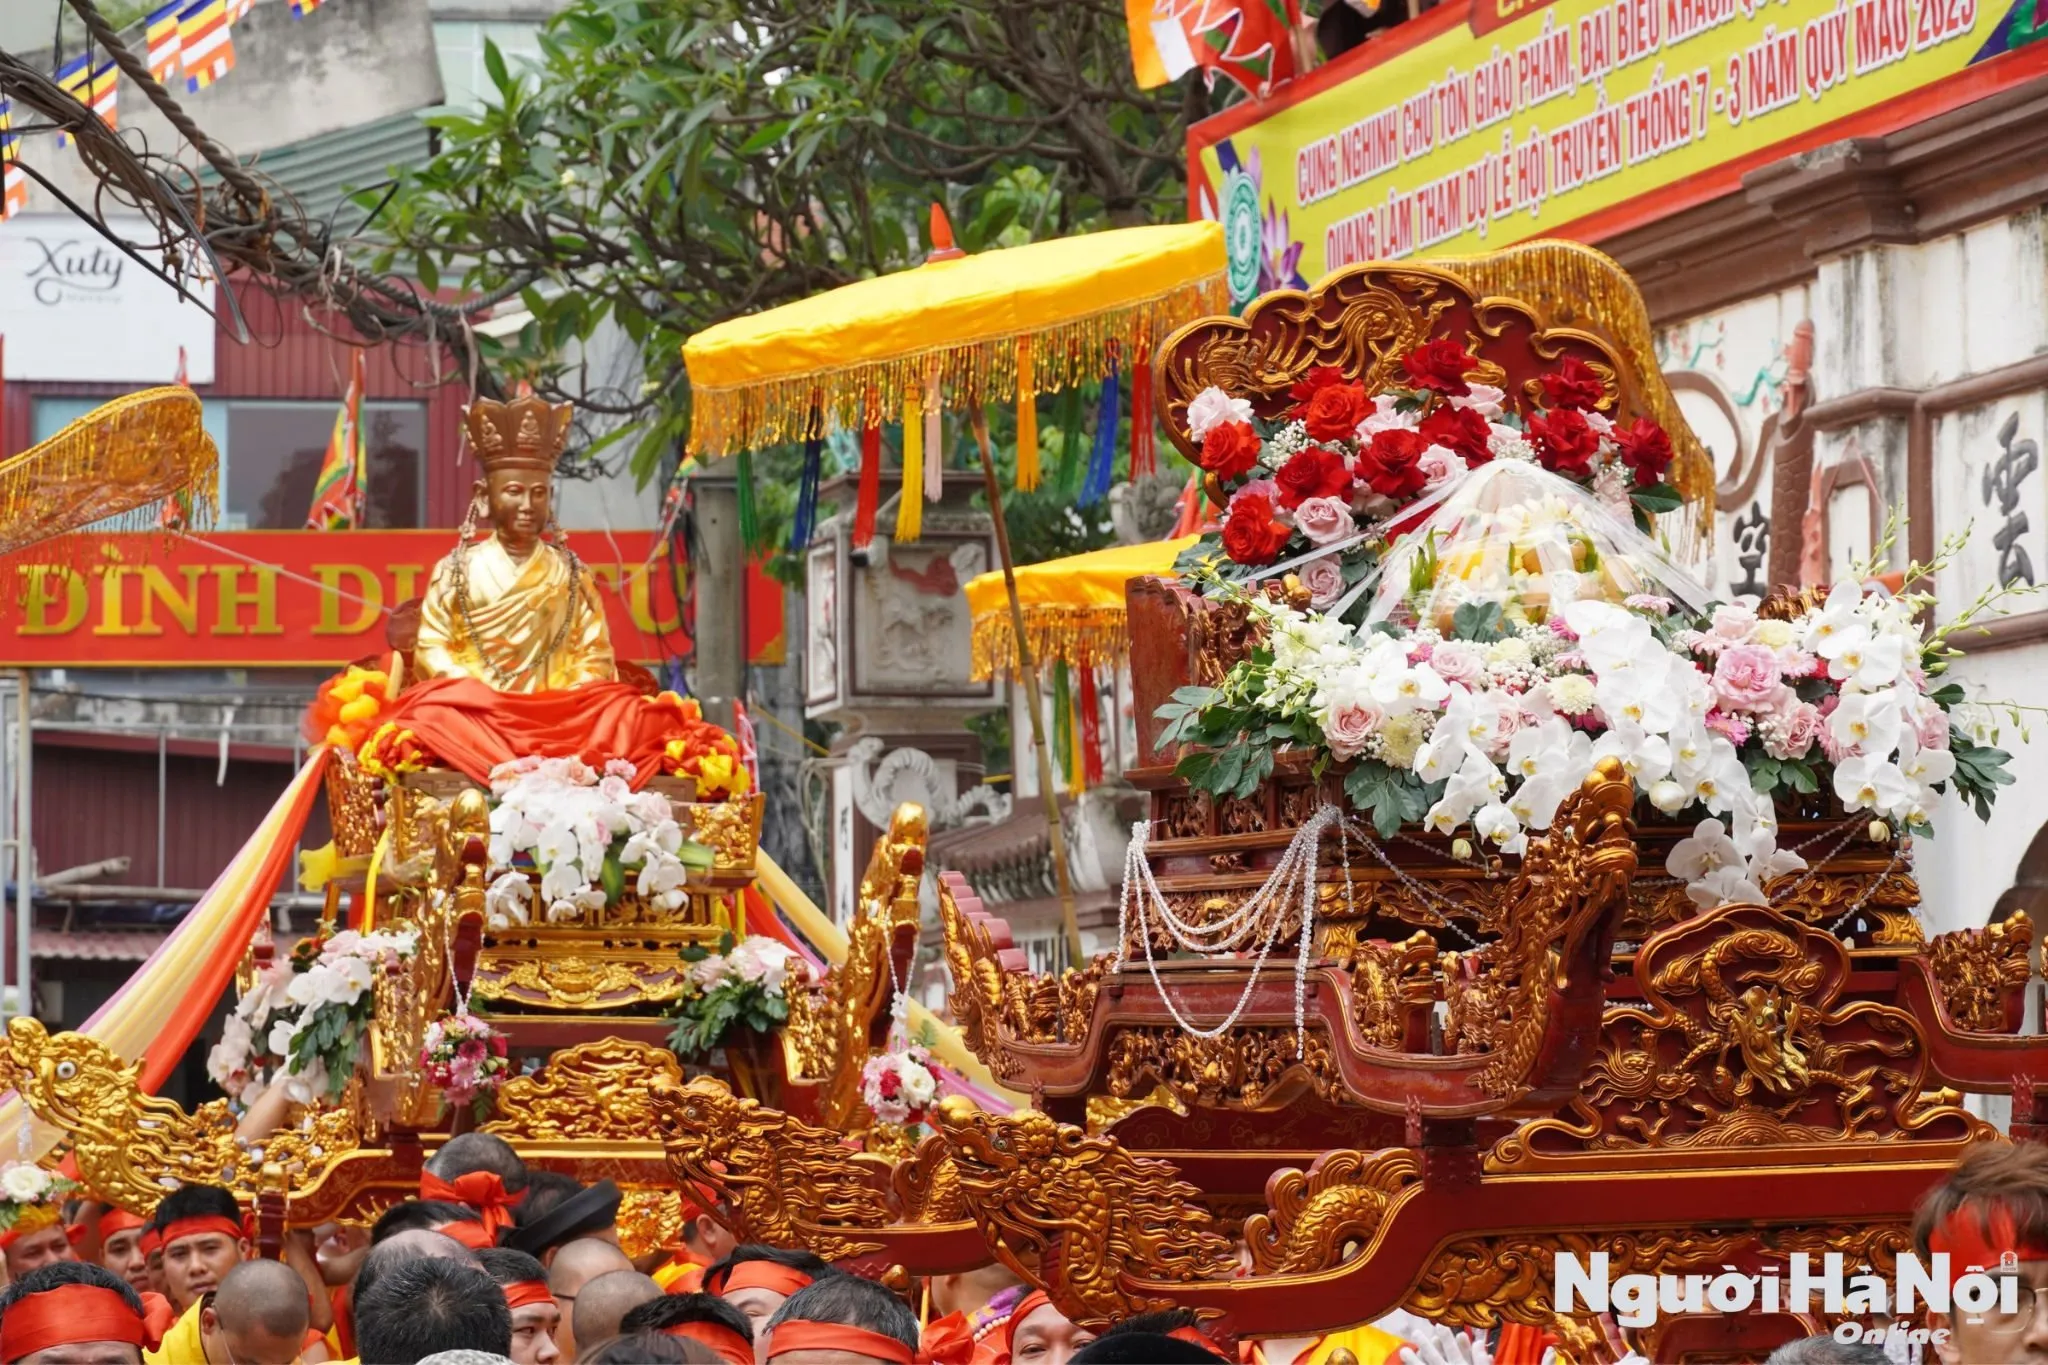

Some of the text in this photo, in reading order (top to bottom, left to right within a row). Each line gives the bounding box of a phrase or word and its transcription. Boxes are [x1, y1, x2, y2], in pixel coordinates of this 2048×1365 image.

[1298, 135, 1338, 205] CUNG
[1341, 107, 1398, 188] NGHINH
[1403, 83, 1437, 161] CHƯ
[1438, 68, 1470, 145] TÔN
[1474, 46, 1514, 129] GIÁO
[1580, 7, 1613, 91] ĐẠI
[1378, 188, 1414, 259] LÂM
[1416, 172, 1463, 248] THAM
[1466, 153, 1490, 237] DỰ
[1516, 126, 1547, 216] HỘI
[1551, 90, 1622, 195] TRUYỀN
[1626, 63, 1692, 165] THỐNG
[1695, 67, 1710, 139] 7
[1728, 53, 1742, 125] 3
[1747, 25, 1799, 119] NĂM
[16, 542, 285, 635] ĐÌNH
